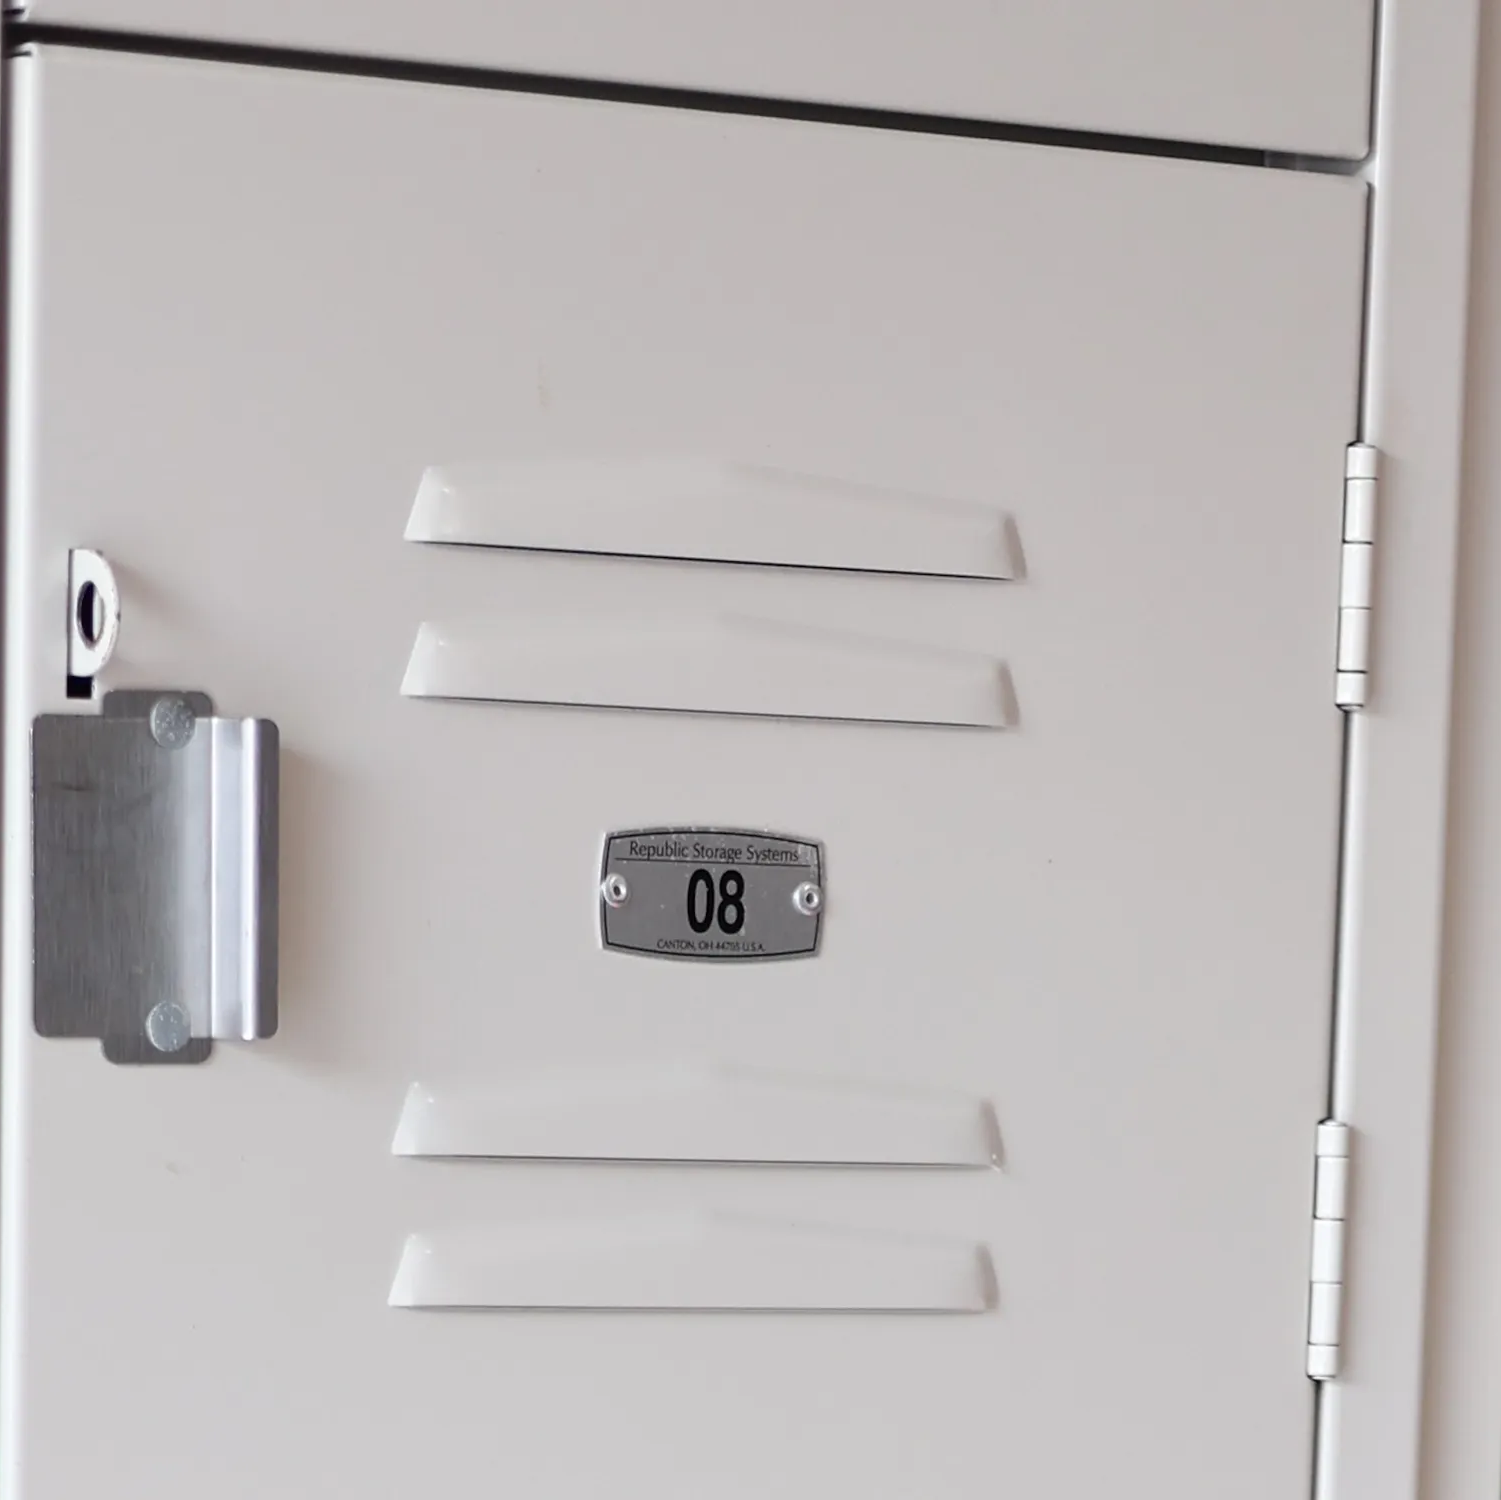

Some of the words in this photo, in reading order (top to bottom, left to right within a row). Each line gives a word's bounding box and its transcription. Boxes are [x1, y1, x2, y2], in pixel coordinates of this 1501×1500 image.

[629, 840, 689, 860] Republic
[693, 842, 742, 863] Storage
[747, 845, 799, 864] Systems
[687, 868, 745, 934] 08
[698, 939, 713, 950] OH
